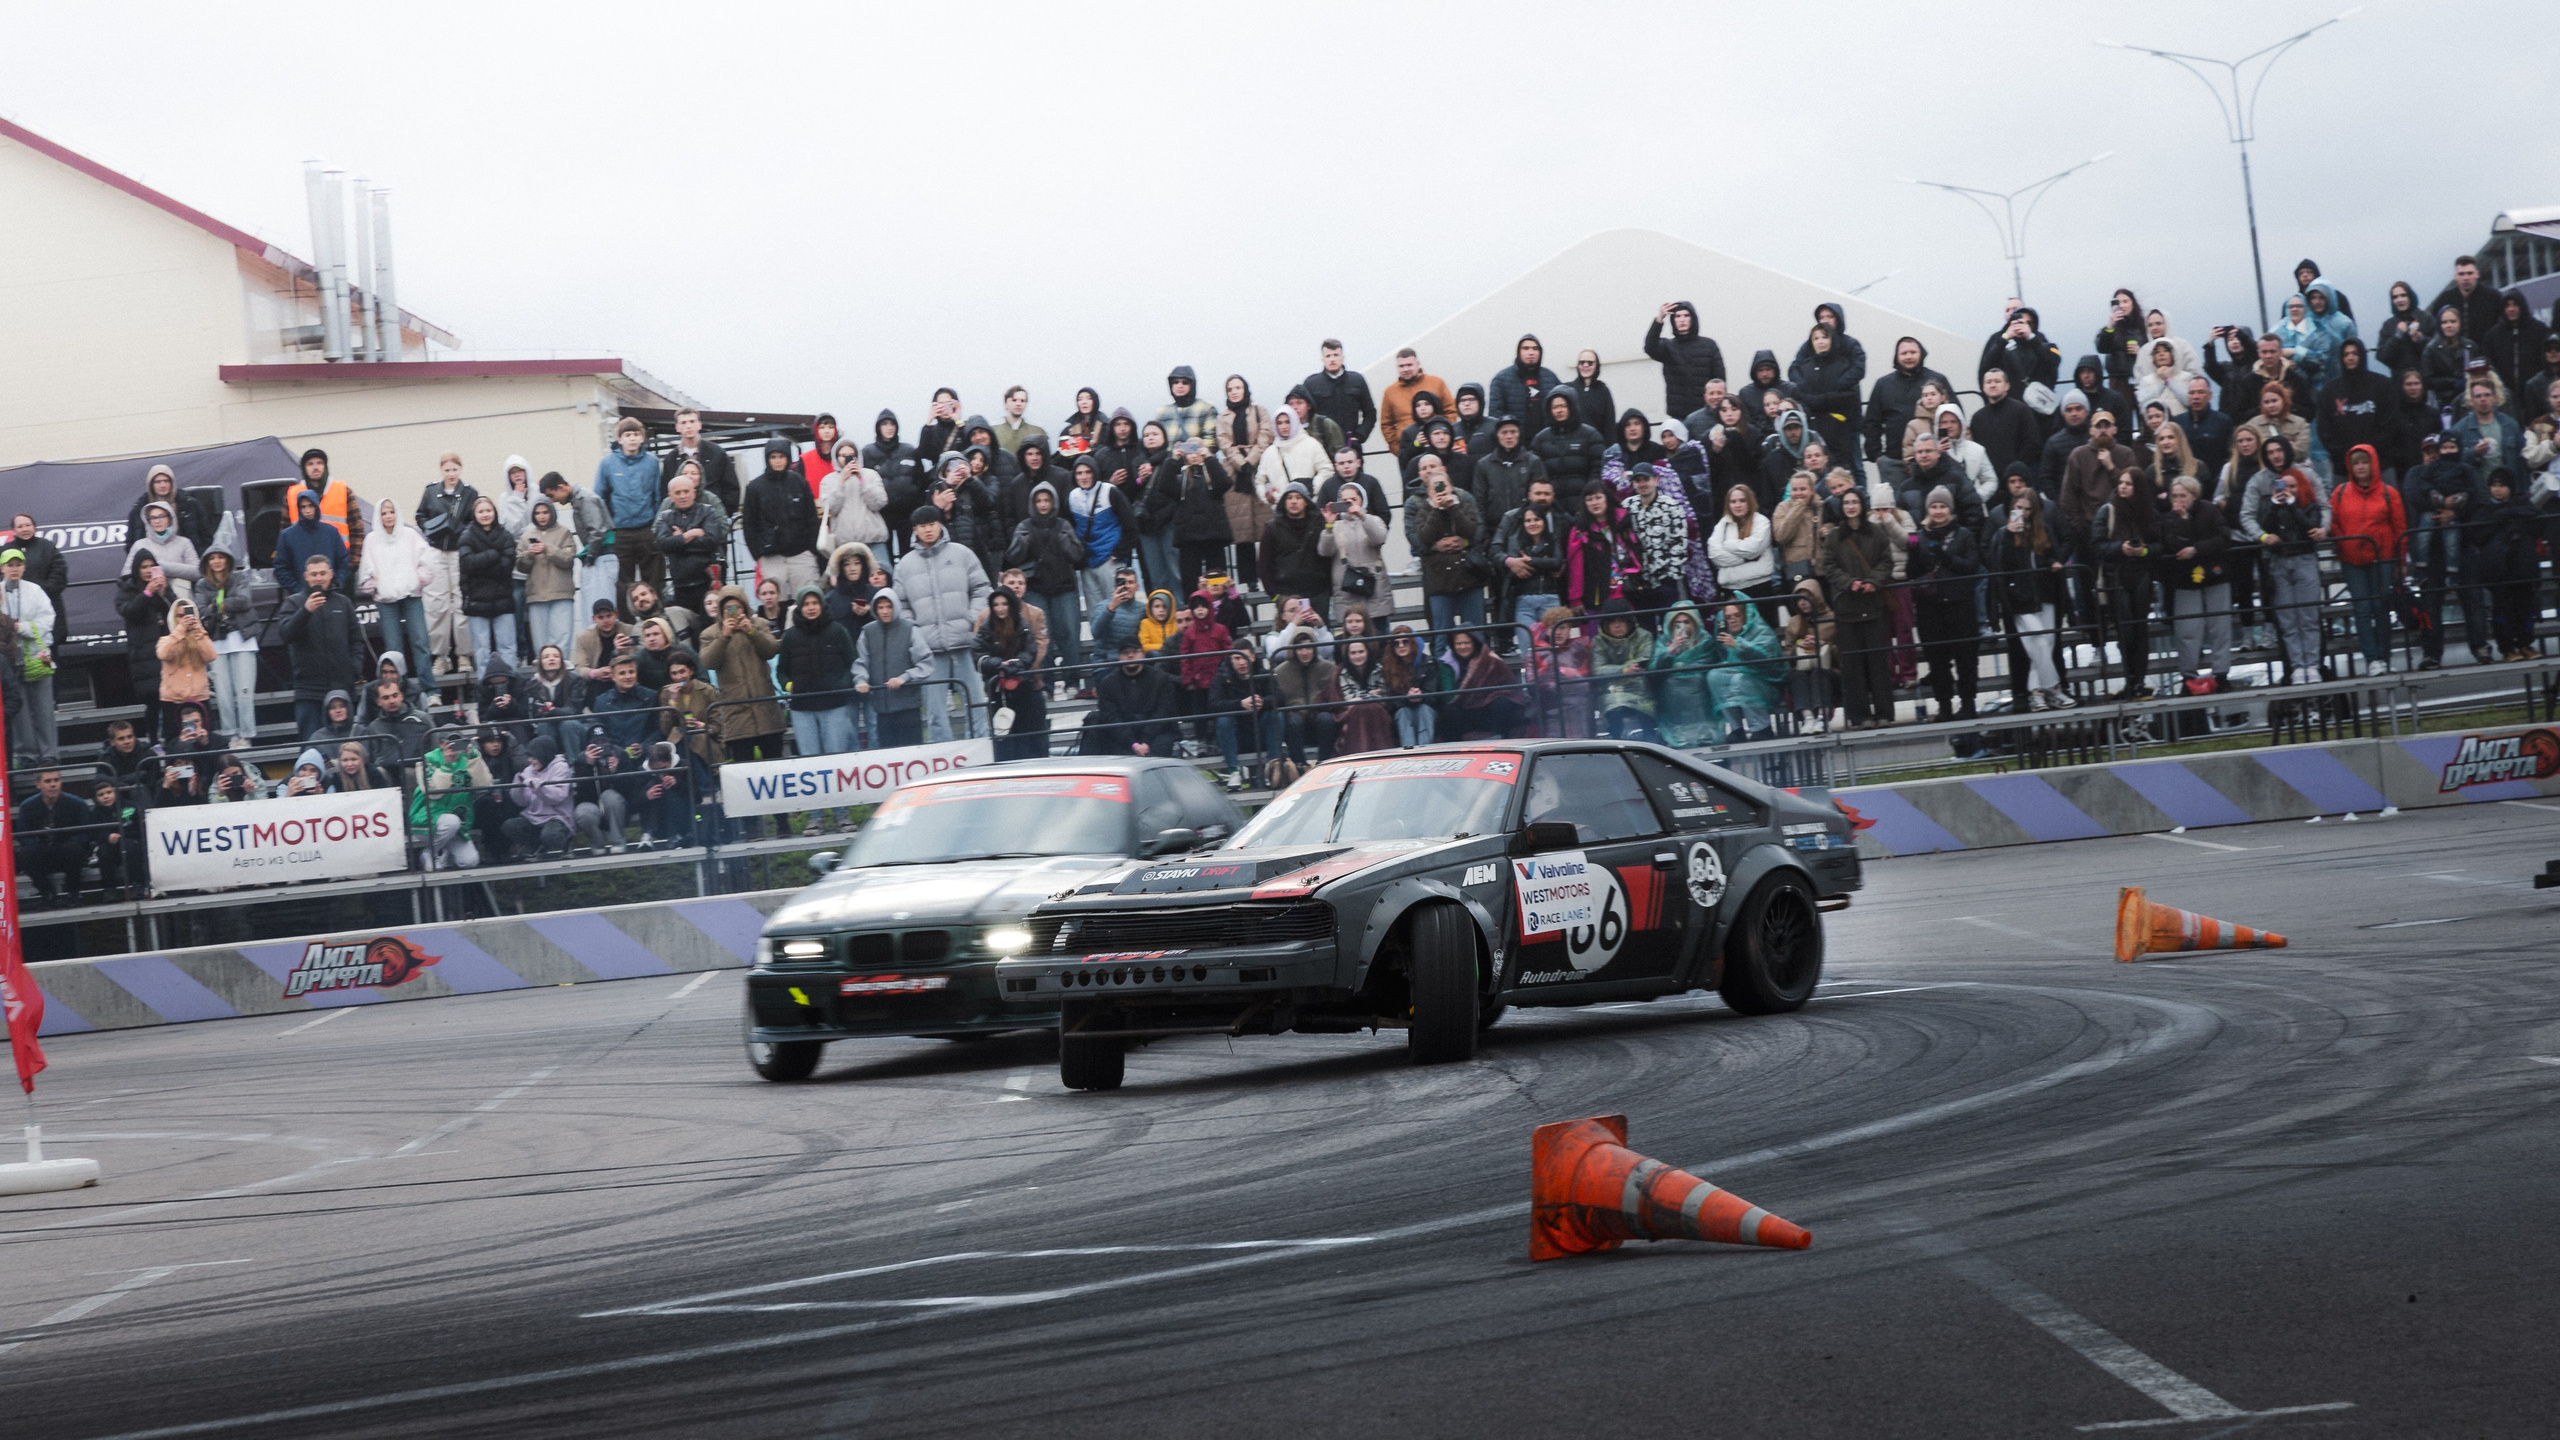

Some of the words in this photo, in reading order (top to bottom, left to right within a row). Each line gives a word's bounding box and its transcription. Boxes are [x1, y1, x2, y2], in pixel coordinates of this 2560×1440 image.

[35, 524, 129, 549] OTOR
[160, 811, 390, 856] WESTMOTORS
[232, 856, 265, 869] Авто
[268, 854, 285, 866] из
[287, 849, 323, 865] США
[1154, 867, 1200, 881] STAYKI
[1200, 866, 1242, 877] DRIFT
[1462, 863, 1497, 887] AEM
[1538, 862, 1585, 880] Valvoline
[1522, 882, 1591, 905] WESTMOTORS
[1540, 912, 1561, 926] RACE
[1561, 908, 1584, 922] LANE
